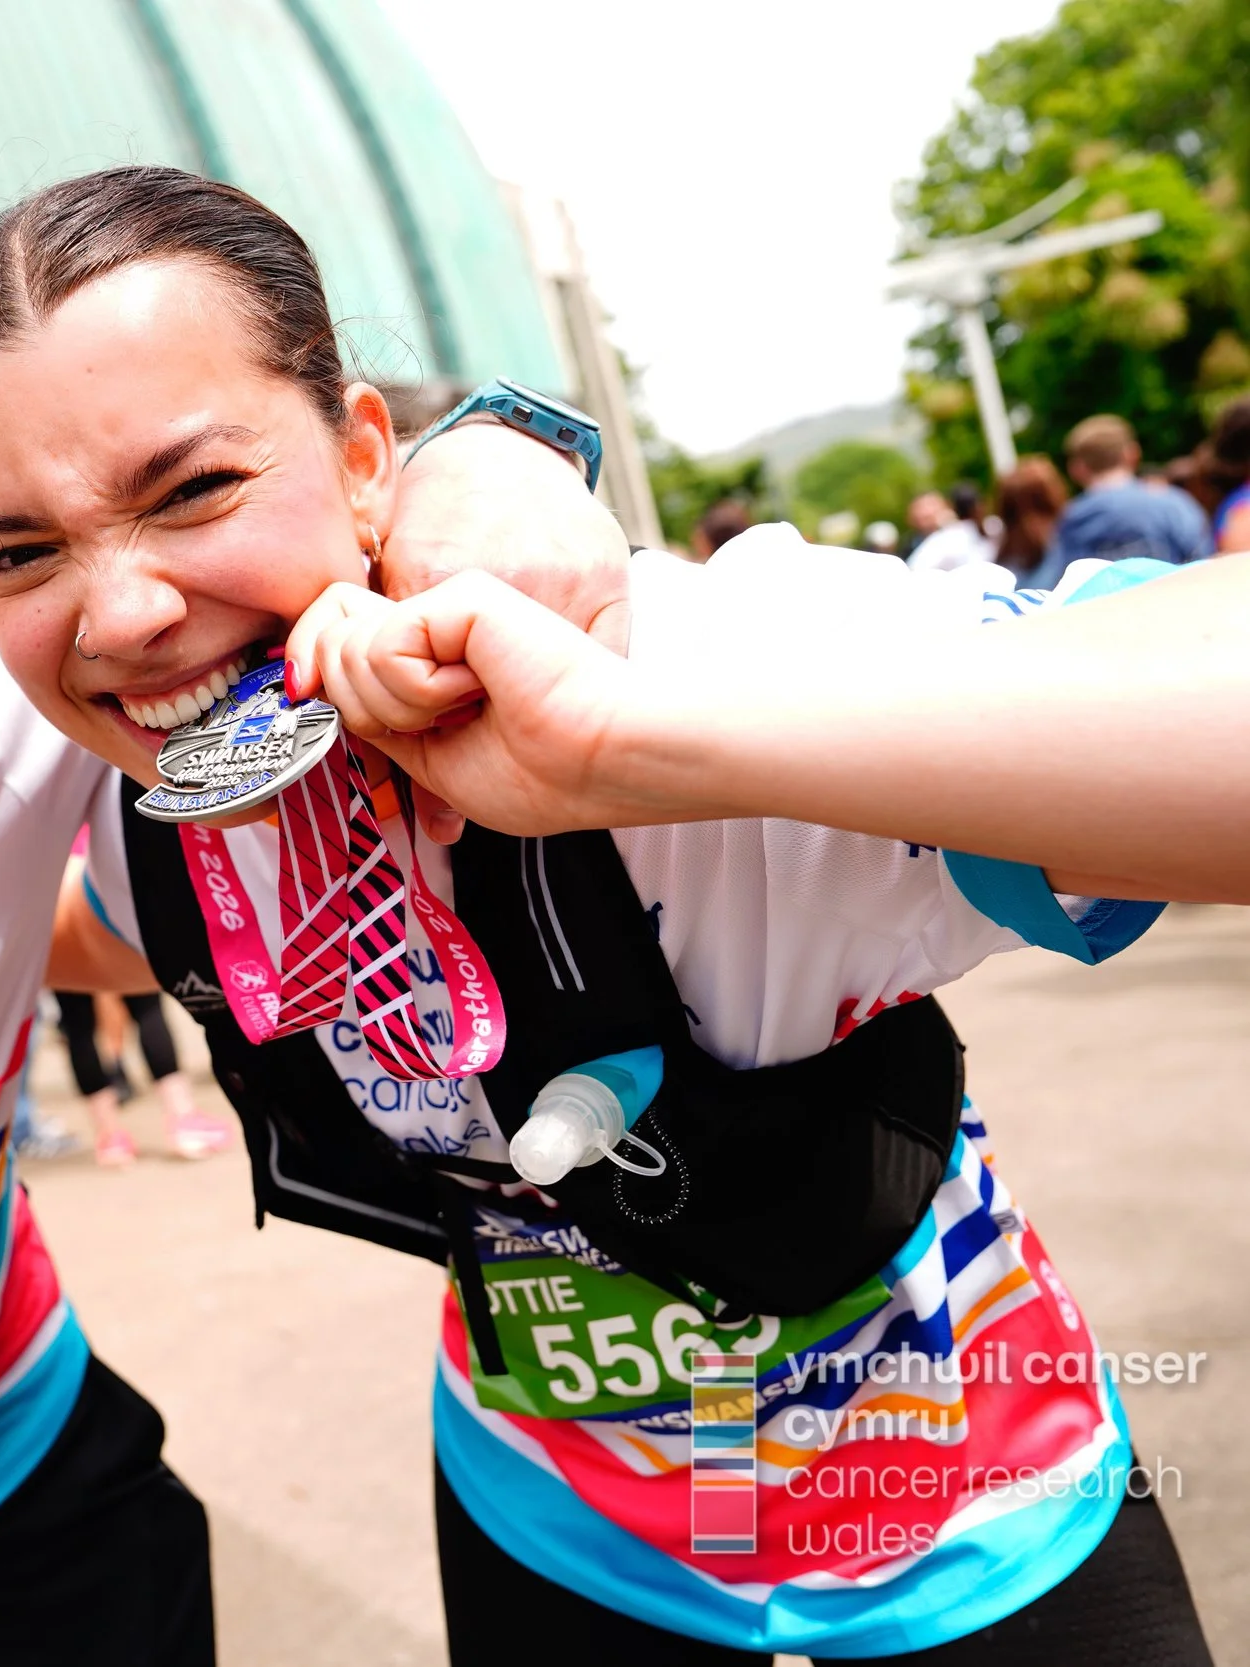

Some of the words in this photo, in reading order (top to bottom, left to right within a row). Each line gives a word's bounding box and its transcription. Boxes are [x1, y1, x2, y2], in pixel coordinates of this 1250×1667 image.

[183, 738, 294, 768] SWANSEA
[148, 771, 276, 811] #RUNSWANSEA
[203, 773, 245, 789] 2026
[199, 851, 245, 932] 2026
